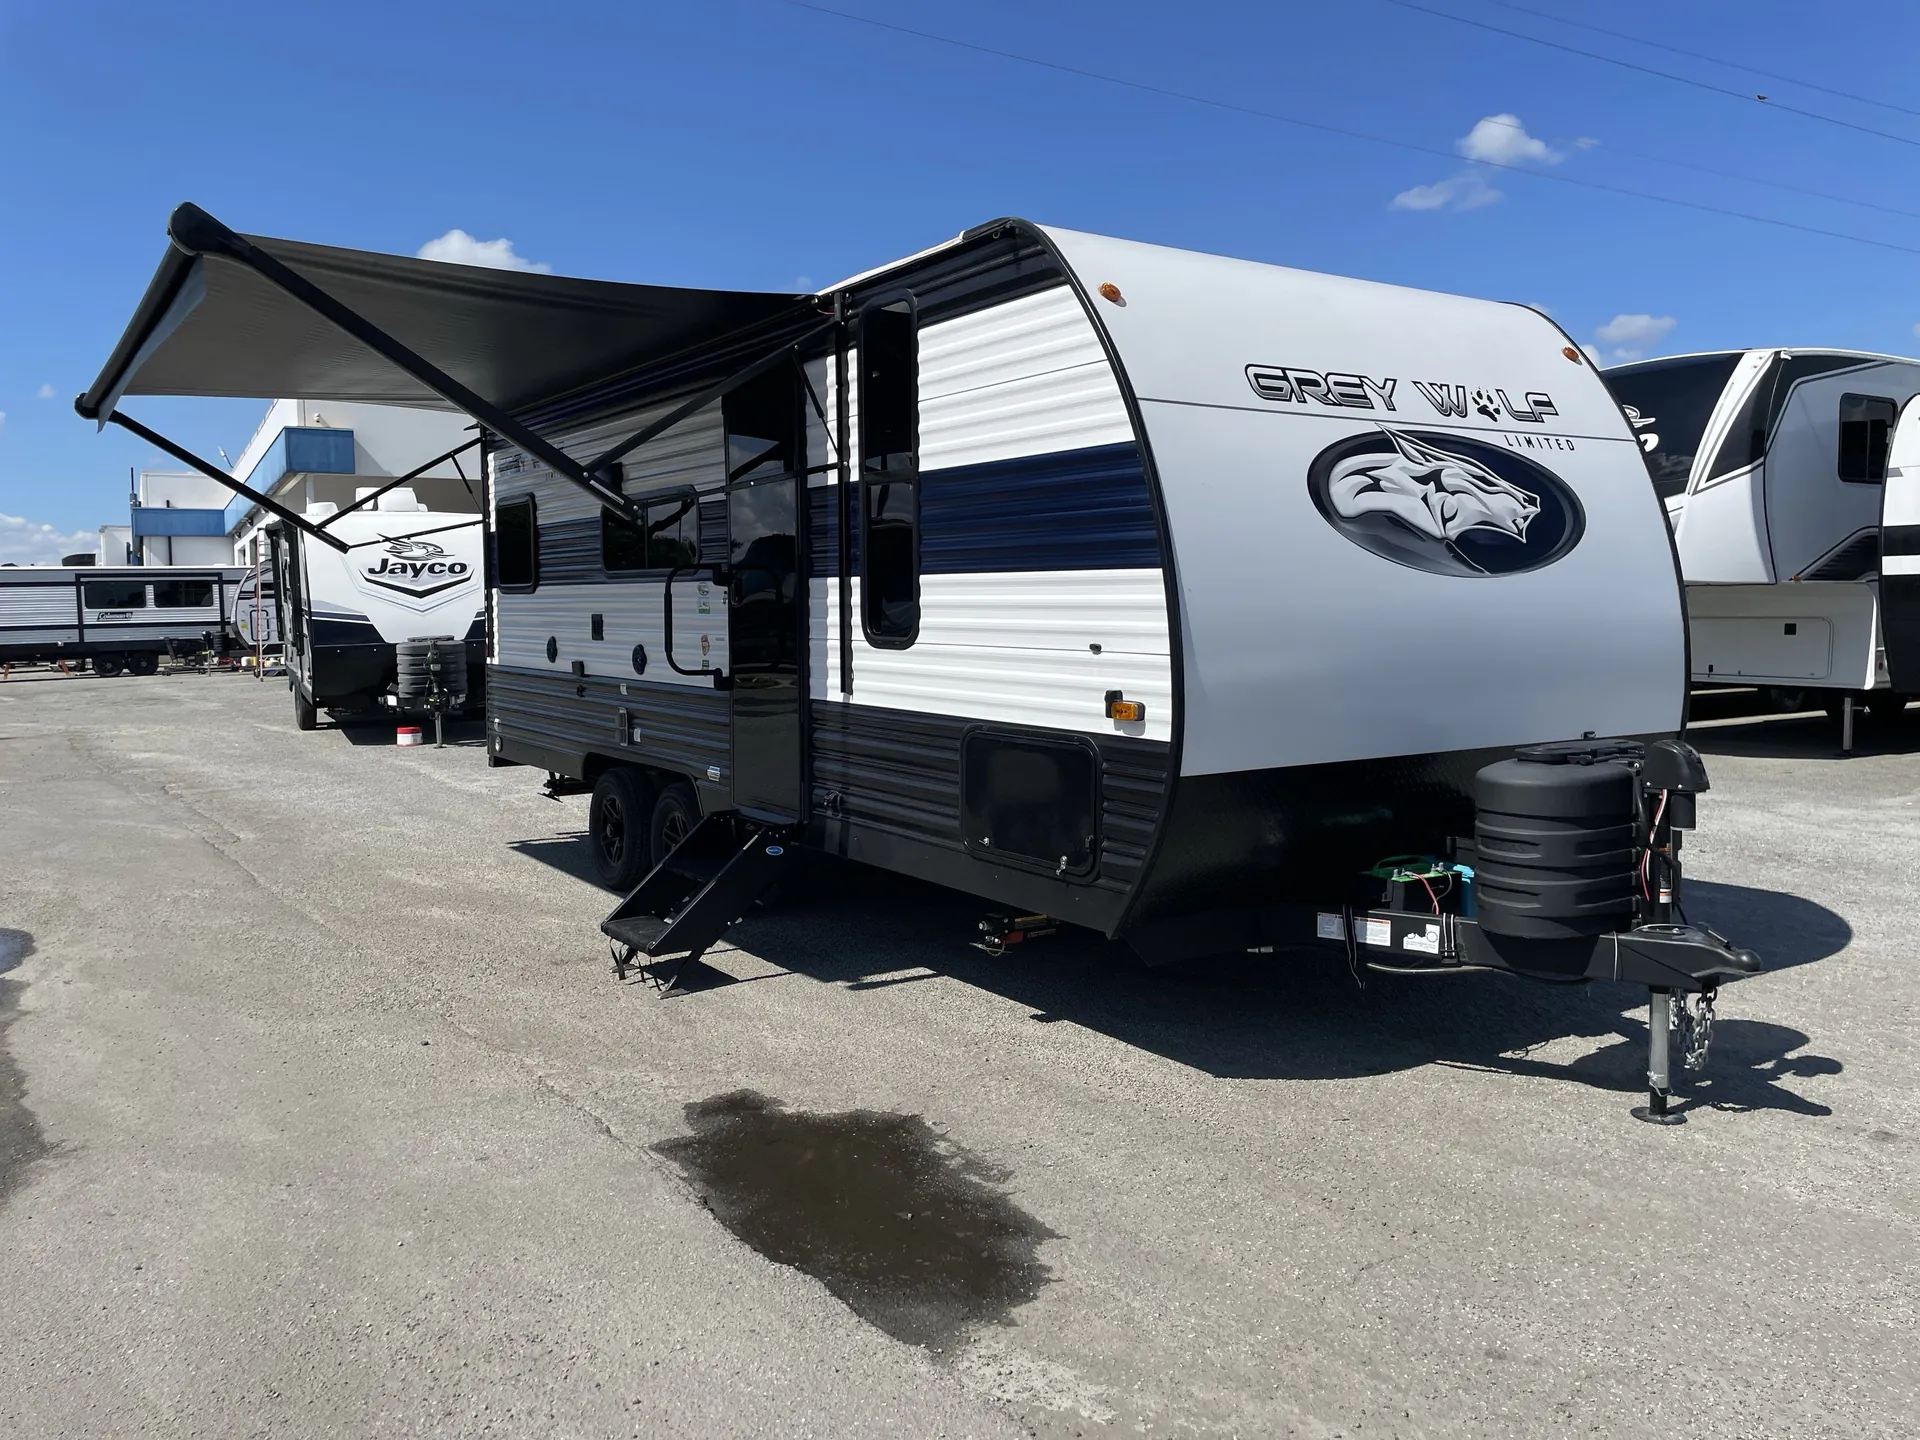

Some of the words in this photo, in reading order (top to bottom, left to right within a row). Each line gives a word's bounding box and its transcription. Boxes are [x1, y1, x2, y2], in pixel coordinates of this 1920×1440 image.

[1244, 363, 1397, 411] GREY
[1504, 434, 1575, 451] LIMITED
[367, 558, 468, 579] Jayco
